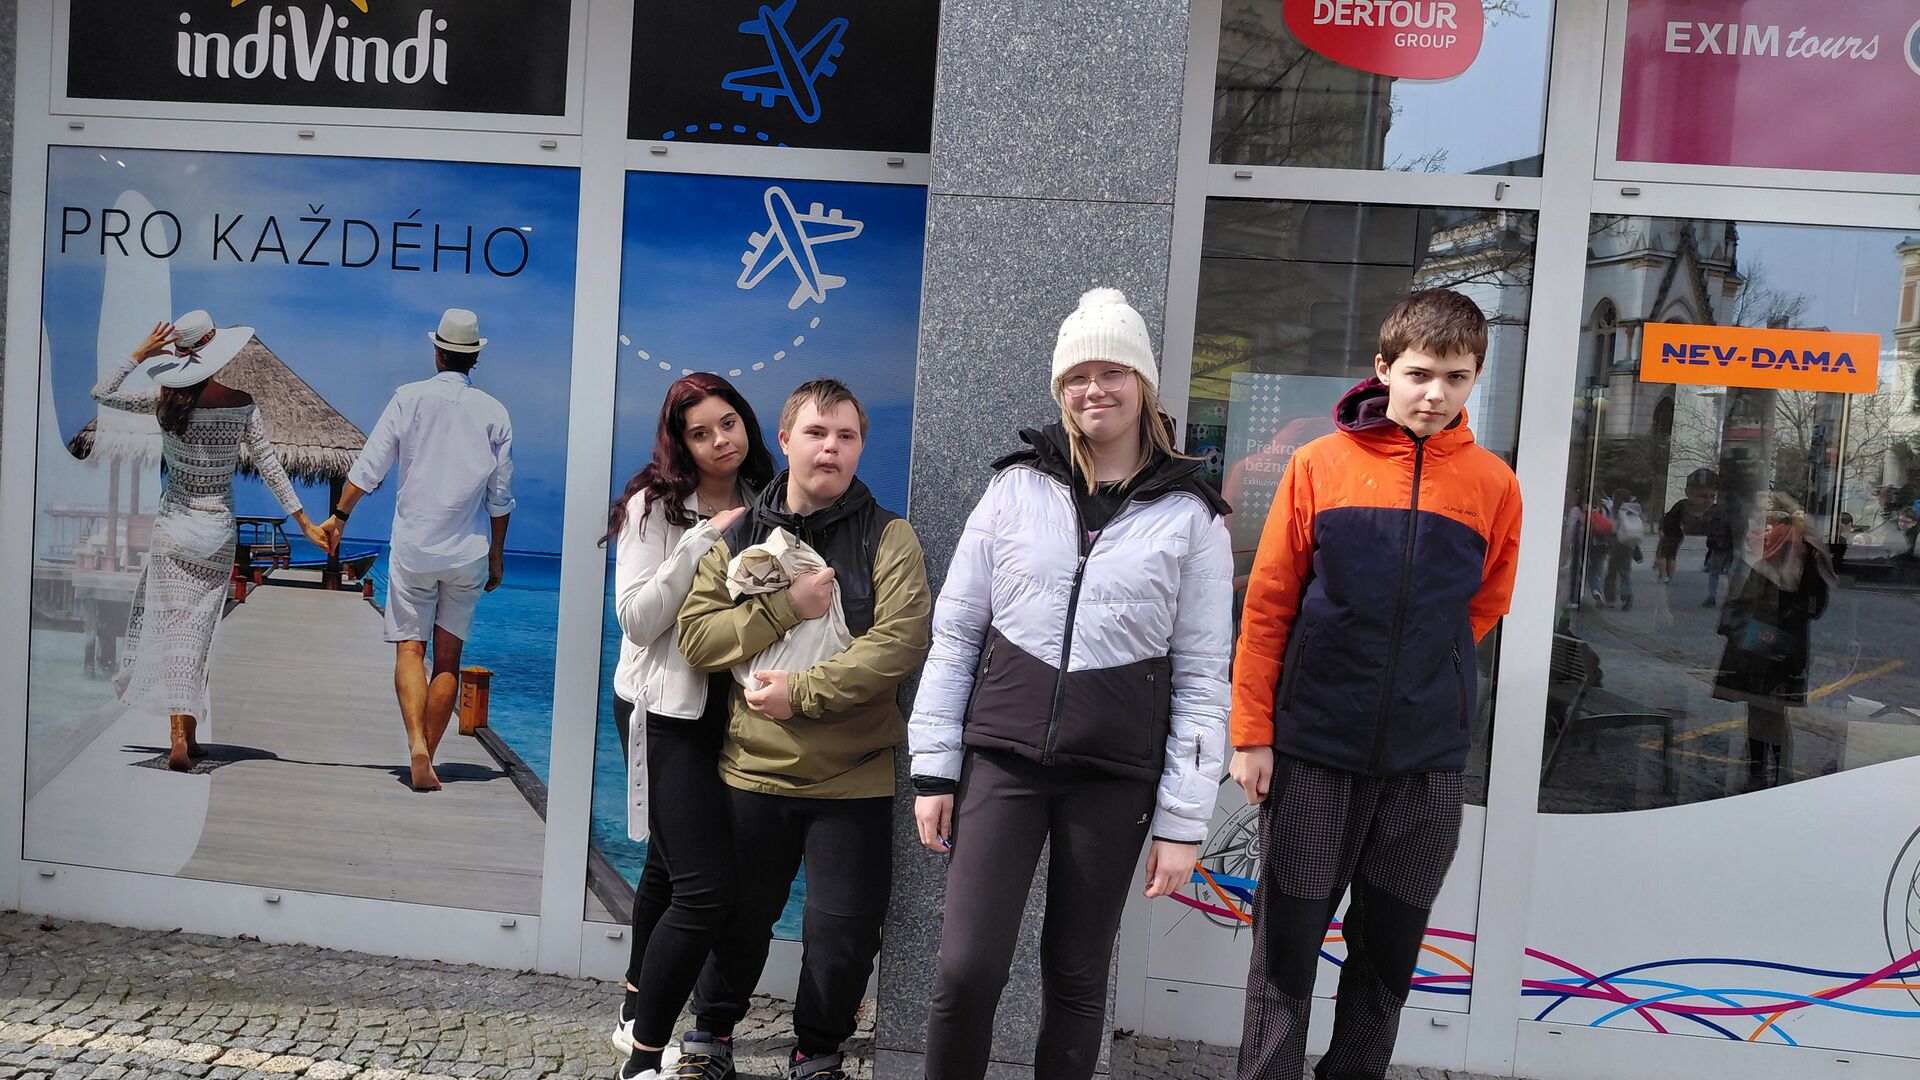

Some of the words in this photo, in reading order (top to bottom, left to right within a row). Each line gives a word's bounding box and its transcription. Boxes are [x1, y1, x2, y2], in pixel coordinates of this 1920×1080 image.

[1313, 0, 1458, 29] DERTOUR
[177, 3, 448, 85] indiVindi
[1394, 33, 1457, 49] GROUP
[1665, 21, 1780, 57] EXIM
[1785, 26, 1880, 60] tours
[61, 207, 182, 258] PRO
[212, 203, 529, 277] KAŽDÉHO
[1661, 342, 1857, 374] NEV-DAMA
[1246, 439, 1303, 455] Překro
[1243, 477, 1279, 487] Exkluzivn
